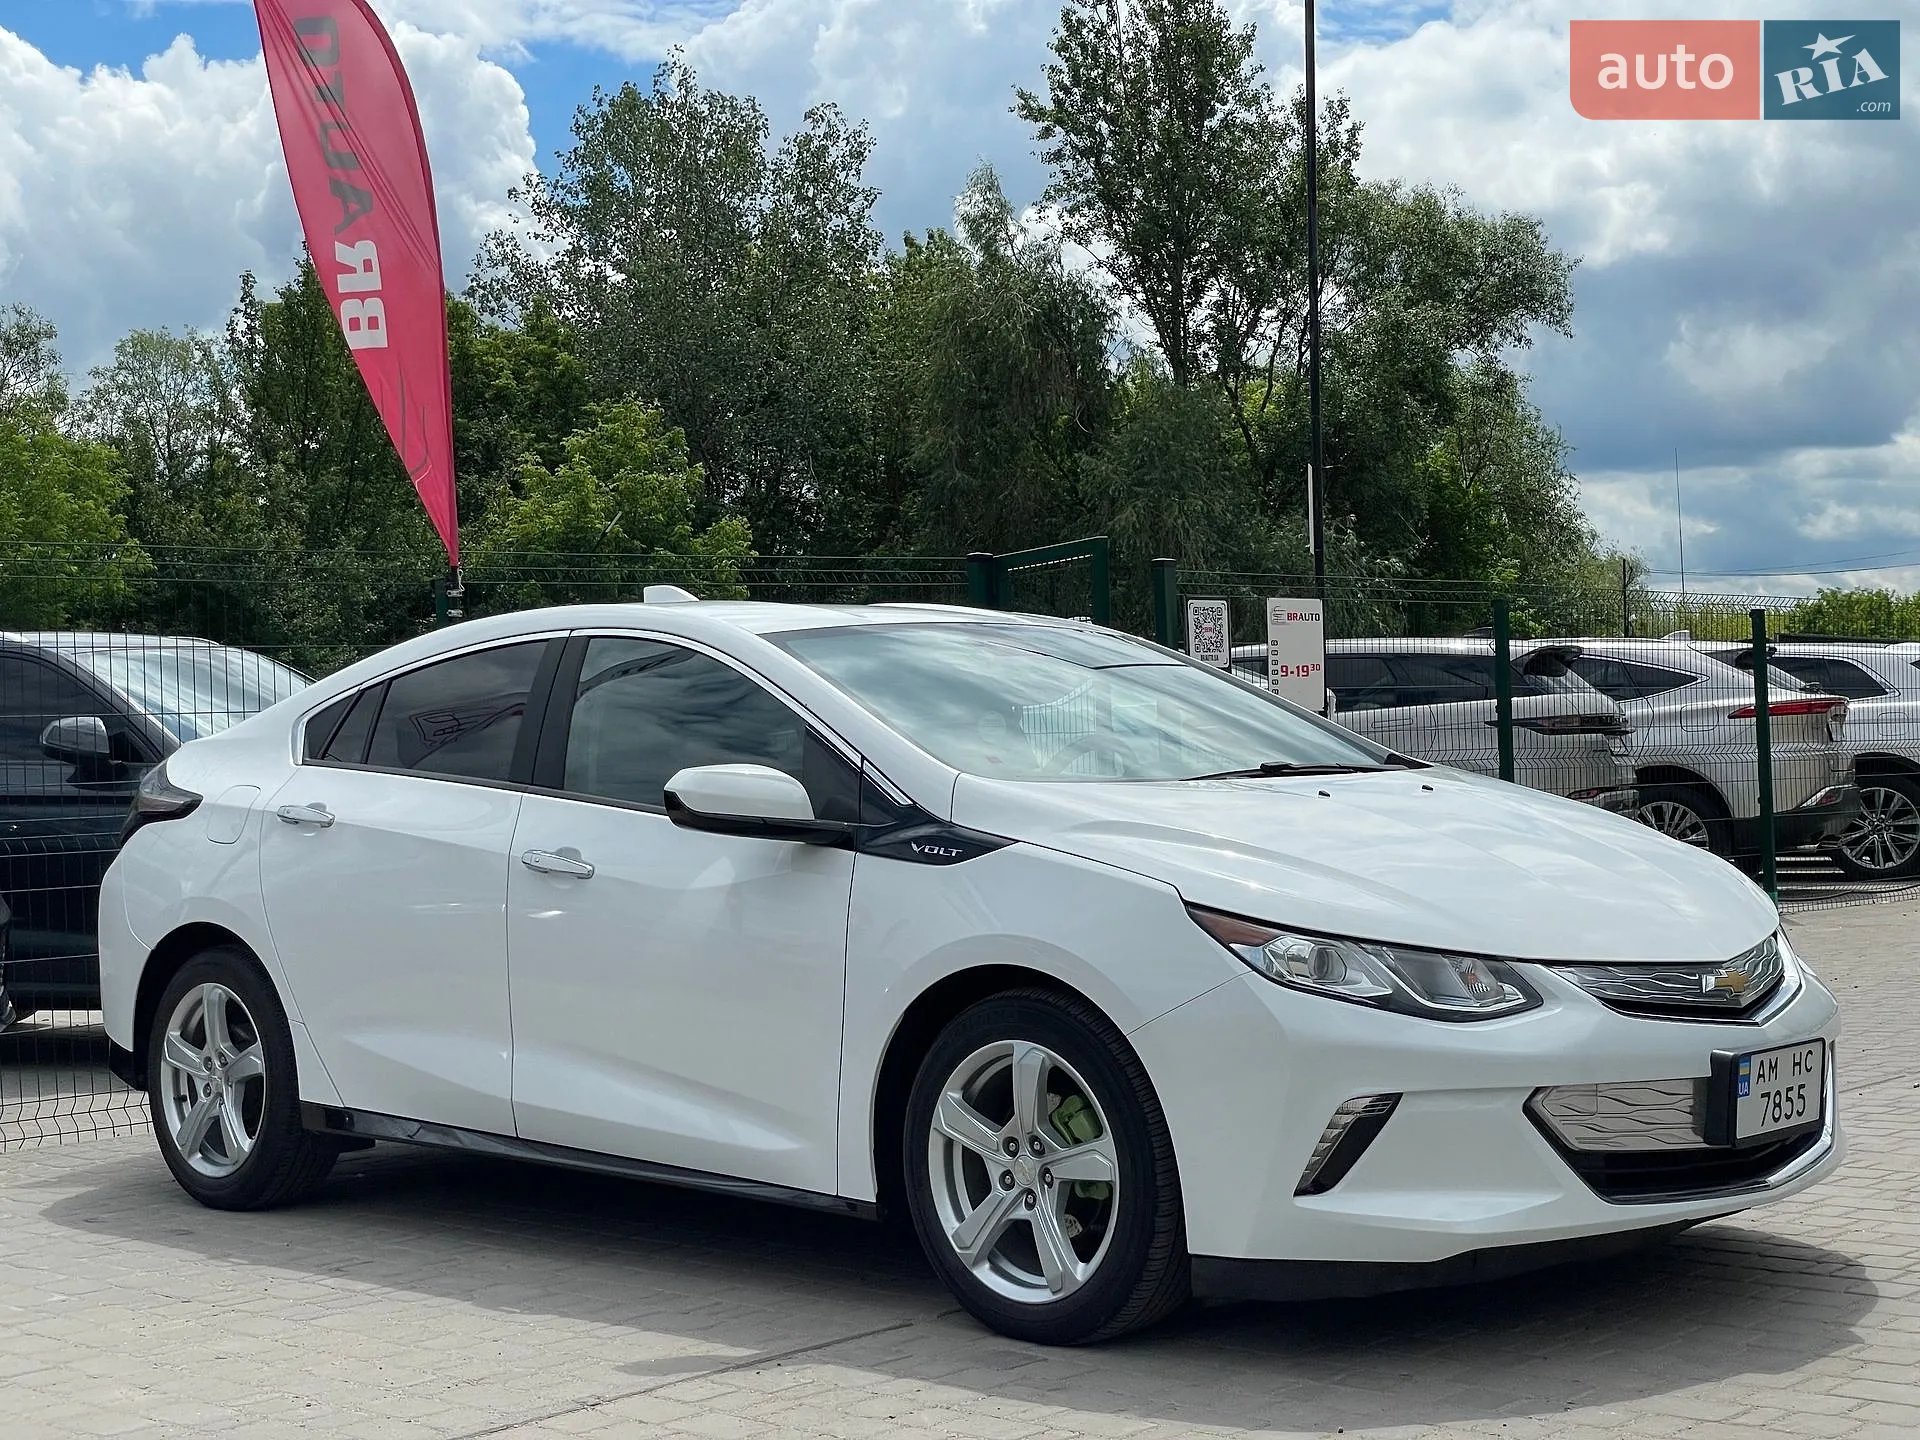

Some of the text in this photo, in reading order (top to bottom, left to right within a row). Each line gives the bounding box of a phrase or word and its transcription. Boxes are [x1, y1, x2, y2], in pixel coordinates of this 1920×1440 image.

[1287, 612, 1321, 622] BRAUTO
[911, 841, 963, 857] VOLT
[1756, 1050, 1813, 1084] AM HC
[1738, 1082, 1749, 1095] UA
[1760, 1083, 1806, 1127] 7855
